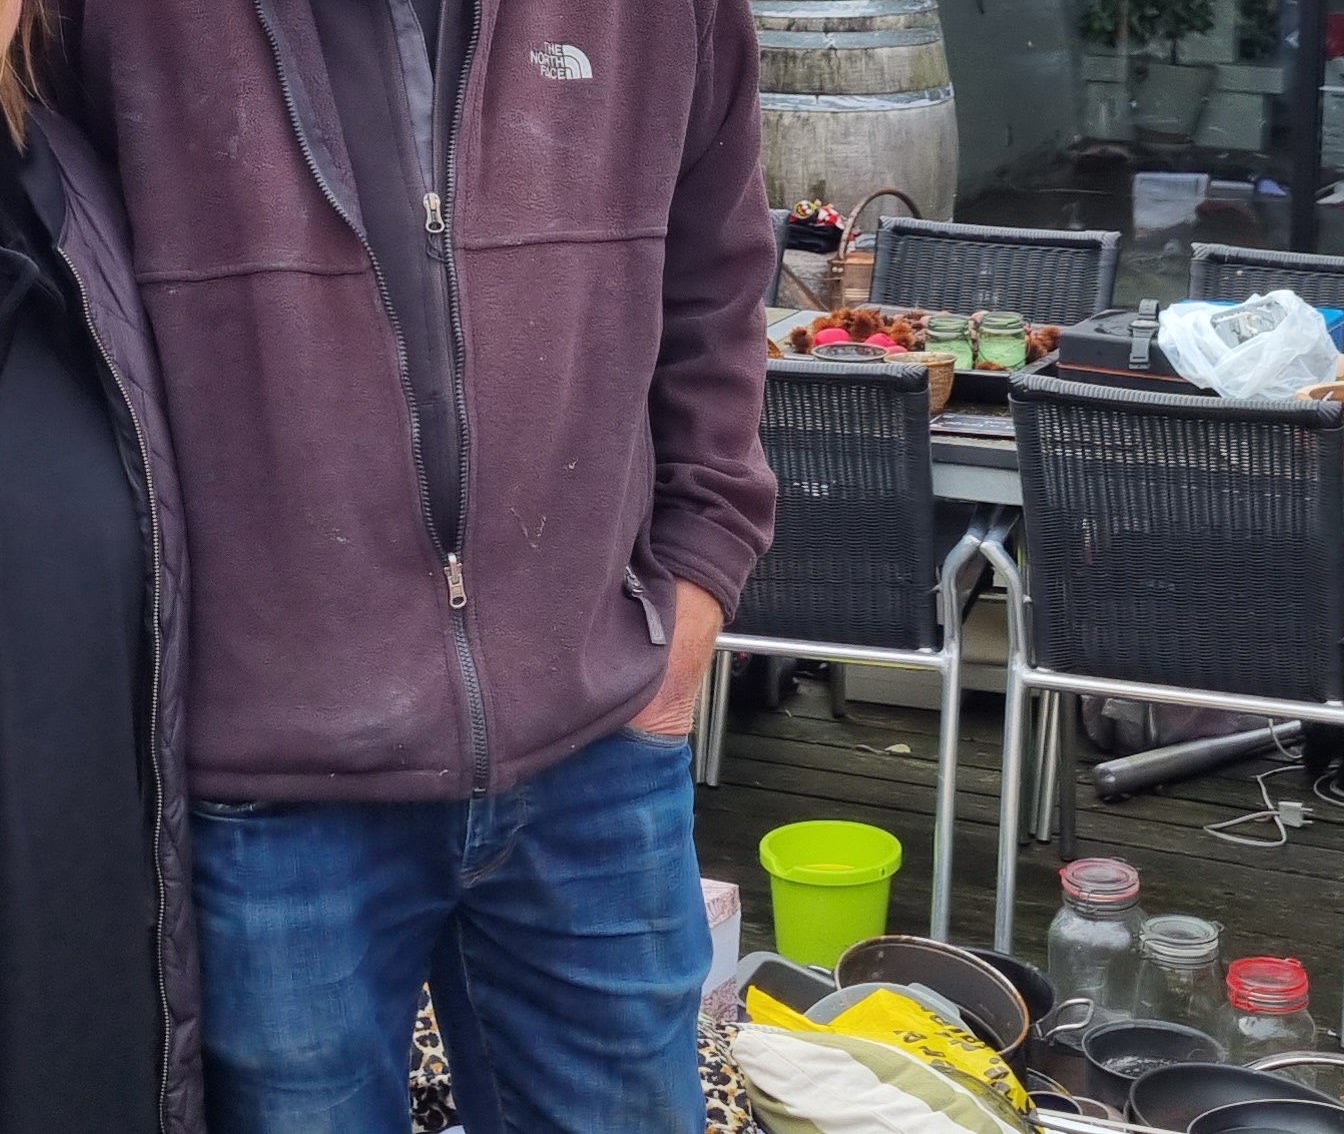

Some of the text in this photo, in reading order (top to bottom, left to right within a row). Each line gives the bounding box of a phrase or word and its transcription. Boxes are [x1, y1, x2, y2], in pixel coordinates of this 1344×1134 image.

[543, 41, 563, 56] THE
[530, 49, 565, 66] NORTH
[540, 66, 566, 80] FACE
